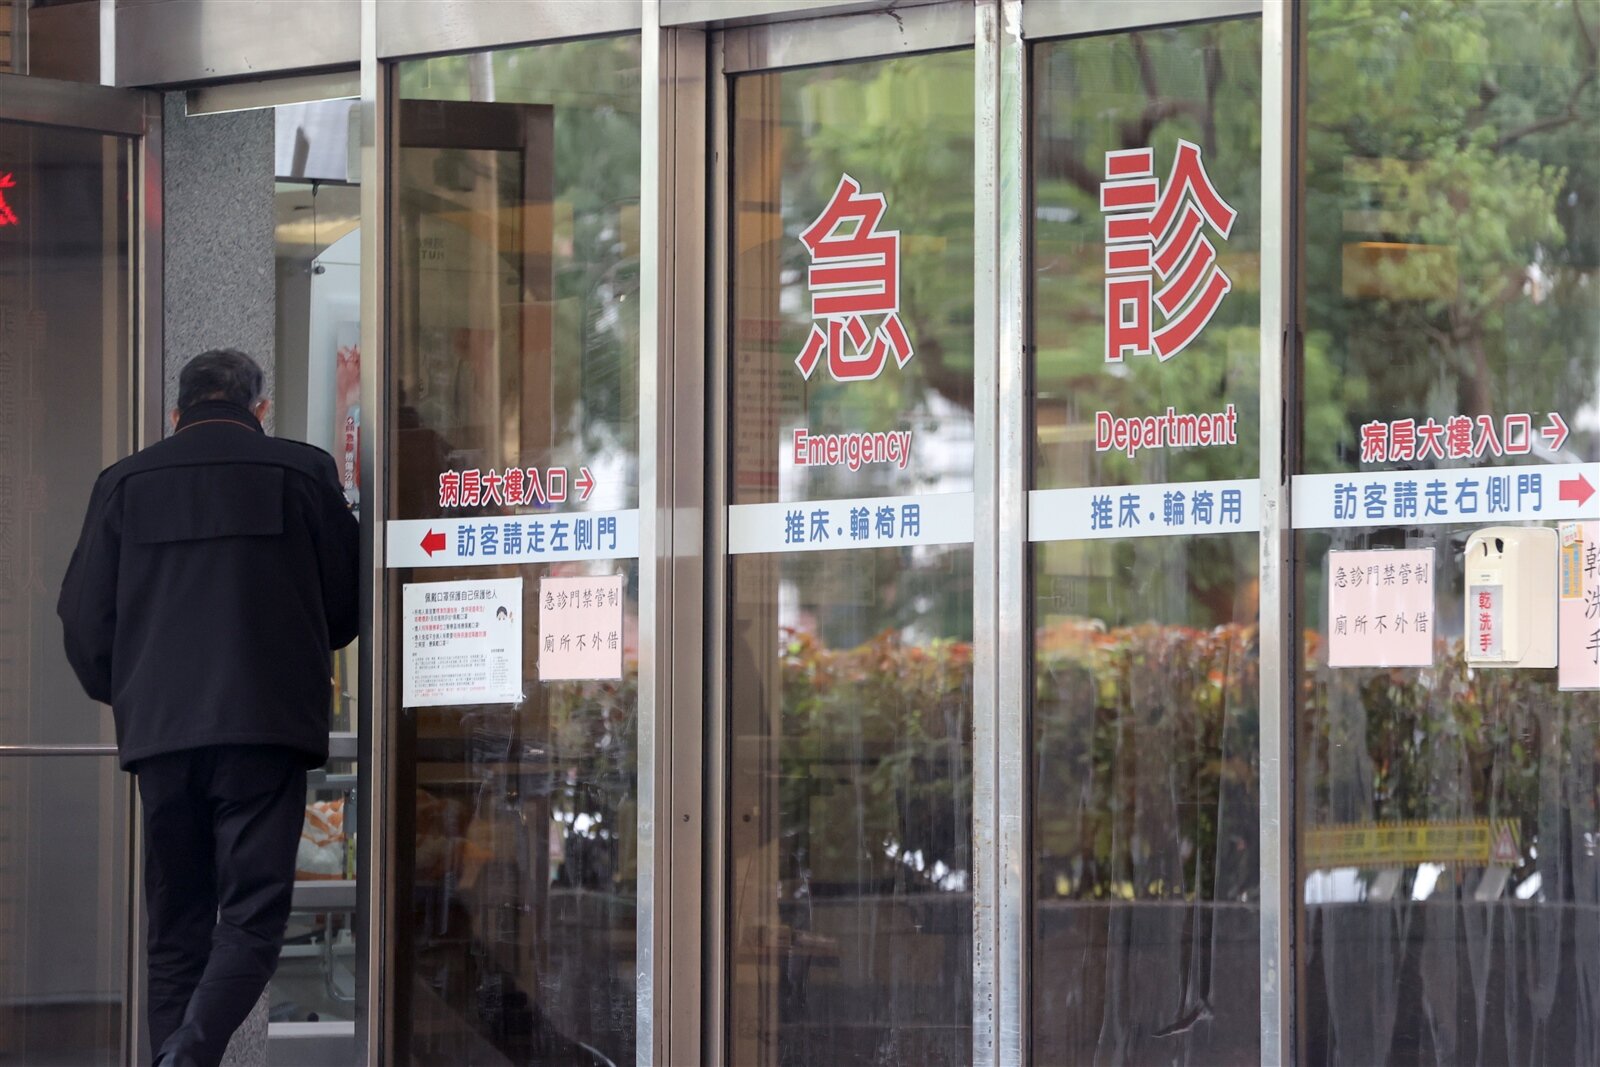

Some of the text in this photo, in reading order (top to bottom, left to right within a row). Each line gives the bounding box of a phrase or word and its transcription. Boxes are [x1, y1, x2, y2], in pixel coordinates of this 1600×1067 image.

[796, 139, 1237, 382] 急 診
[793, 404, 1237, 471] Emergency Department
[1360, 412, 1532, 463] 病房大樓入口
[438, 467, 568, 507] 病房大樓入口
[1334, 473, 1543, 519] 訪客請走右側門
[457, 516, 617, 557] 訪客請走左側門
[1334, 563, 1428, 588] 急診門禁管制
[544, 588, 618, 611] 急診門禁管制
[544, 630, 618, 653] 廁所不外借
[1334, 611, 1429, 636] 廁所不外借
[1479, 591, 1492, 652] 乾洗手
